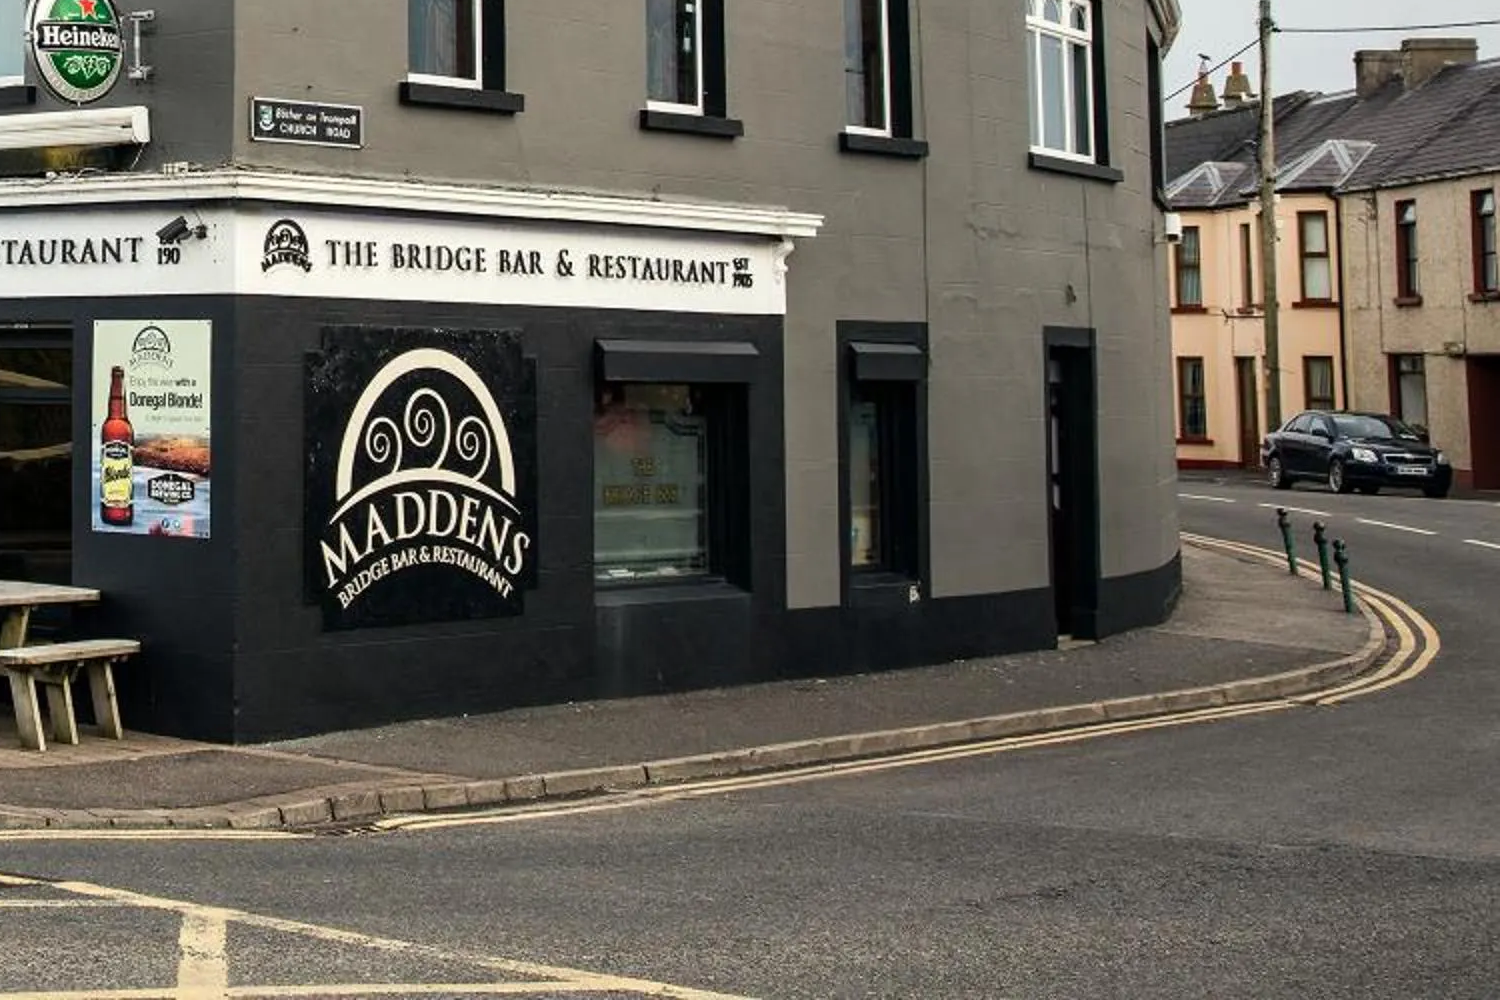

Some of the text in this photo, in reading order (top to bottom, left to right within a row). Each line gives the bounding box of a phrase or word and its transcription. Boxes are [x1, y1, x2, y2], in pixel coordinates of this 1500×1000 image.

[42, 25, 120, 48] Heineken
[280, 121, 351, 139] CHURCH ROAD
[326, 238, 729, 285] THE BRIDGE BAR & RESTAURANT
[129, 391, 203, 411] Donegal Blonde!
[150, 479, 194, 492] DONEGAL
[320, 489, 531, 590] MADDENS
[338, 545, 514, 609] BRIDGE BAR & RESTAURANT
